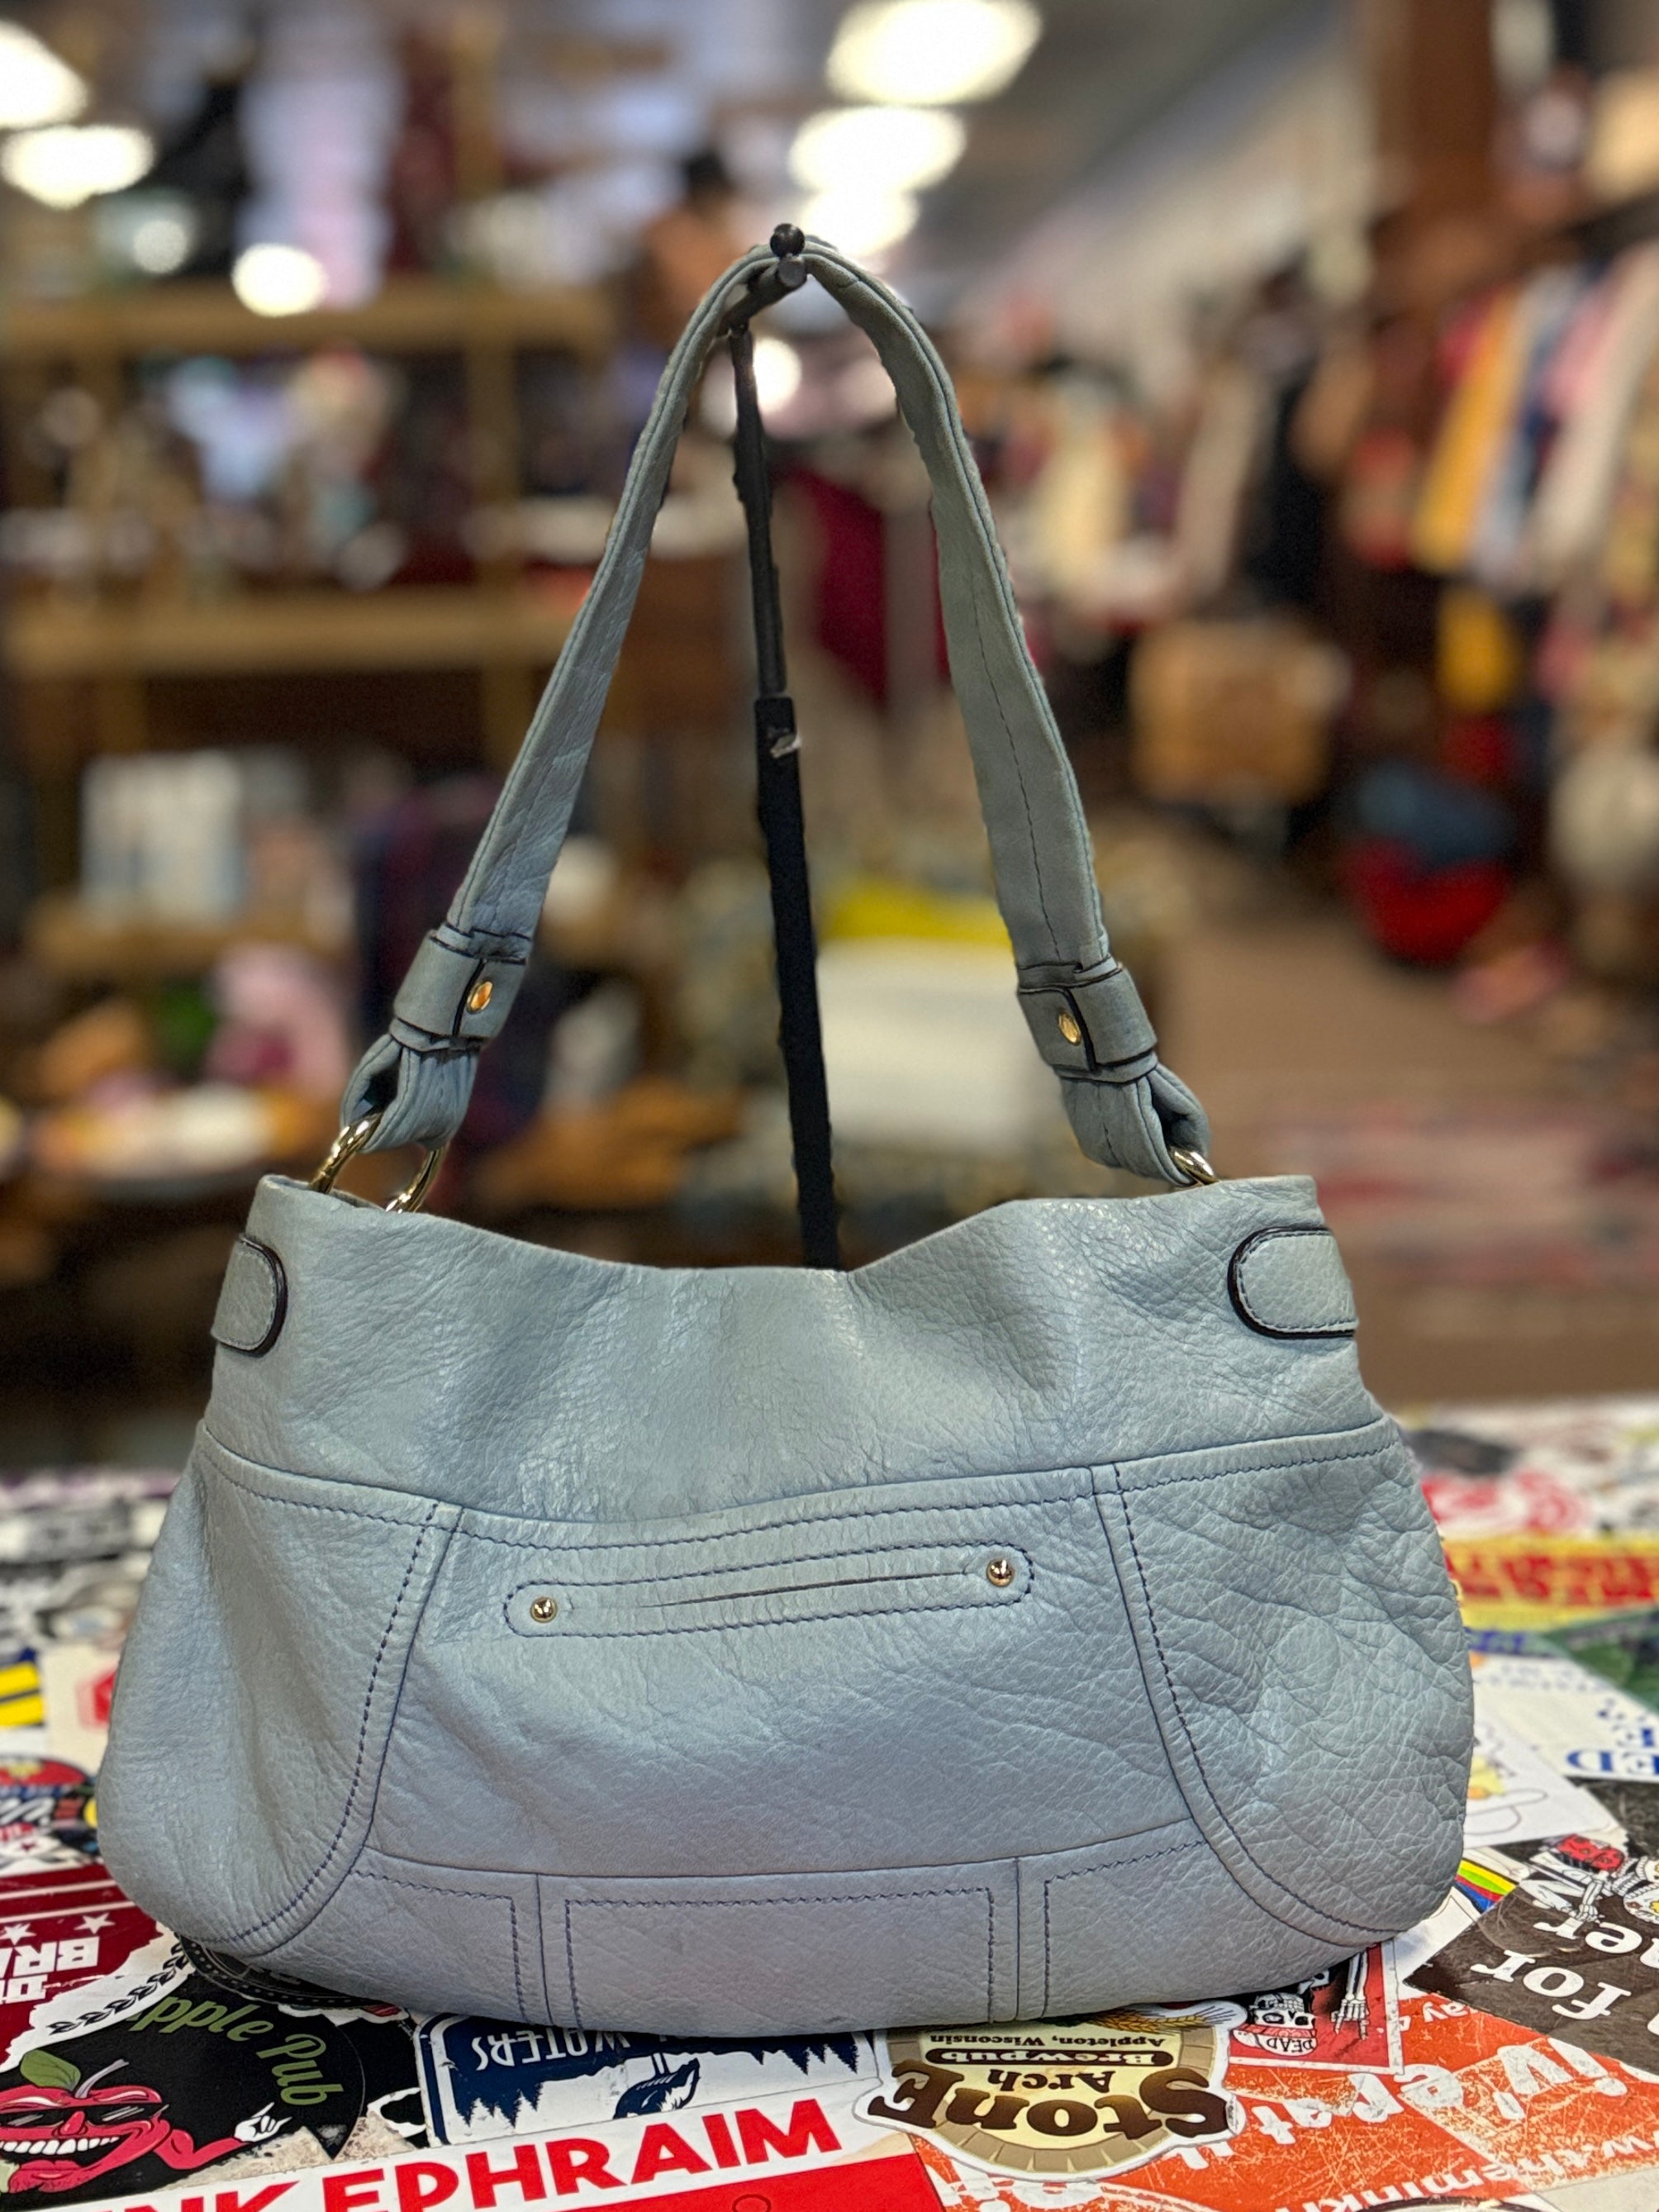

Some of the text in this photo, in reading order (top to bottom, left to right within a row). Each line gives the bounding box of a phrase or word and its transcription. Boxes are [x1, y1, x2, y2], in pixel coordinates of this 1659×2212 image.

[1533, 1917, 1659, 1968] er
[1471, 1950, 1631, 2019] for
[1421, 2001, 1478, 2023] ay
[126, 1996, 344, 2105] pple Pub
[930, 2034, 1166, 2047] Appleton, Wisconsin
[1267, 2037, 1314, 2053] DEAD
[941, 2050, 1155, 2065] Brewpub
[988, 2069, 1115, 2093] Arch
[322, 2098, 843, 2212] EPHRAIM
